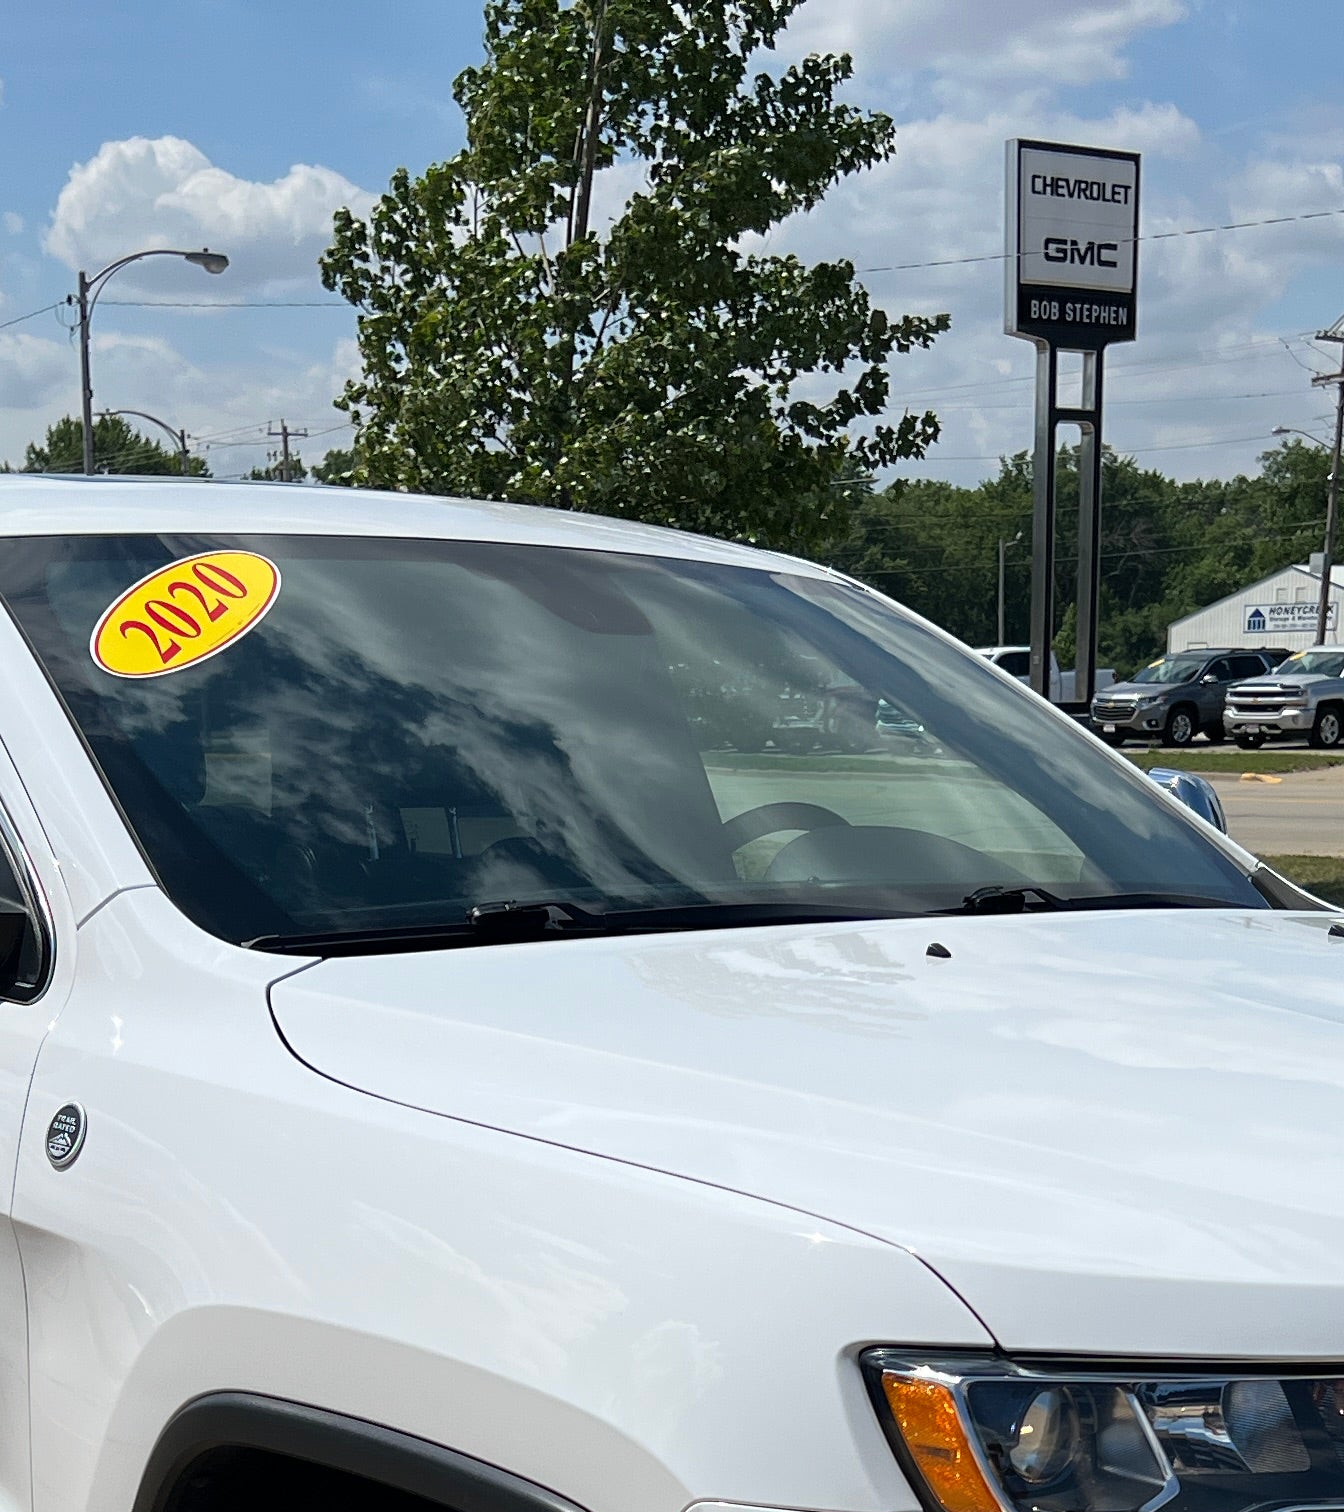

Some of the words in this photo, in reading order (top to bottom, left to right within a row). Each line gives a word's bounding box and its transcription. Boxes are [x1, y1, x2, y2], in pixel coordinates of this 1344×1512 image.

[1031, 174, 1132, 205] CHEVROLET
[1044, 237, 1118, 268] GMC
[1030, 300, 1059, 320] BOB
[1065, 302, 1128, 325] STEPHEN
[119, 562, 248, 664] 2020
